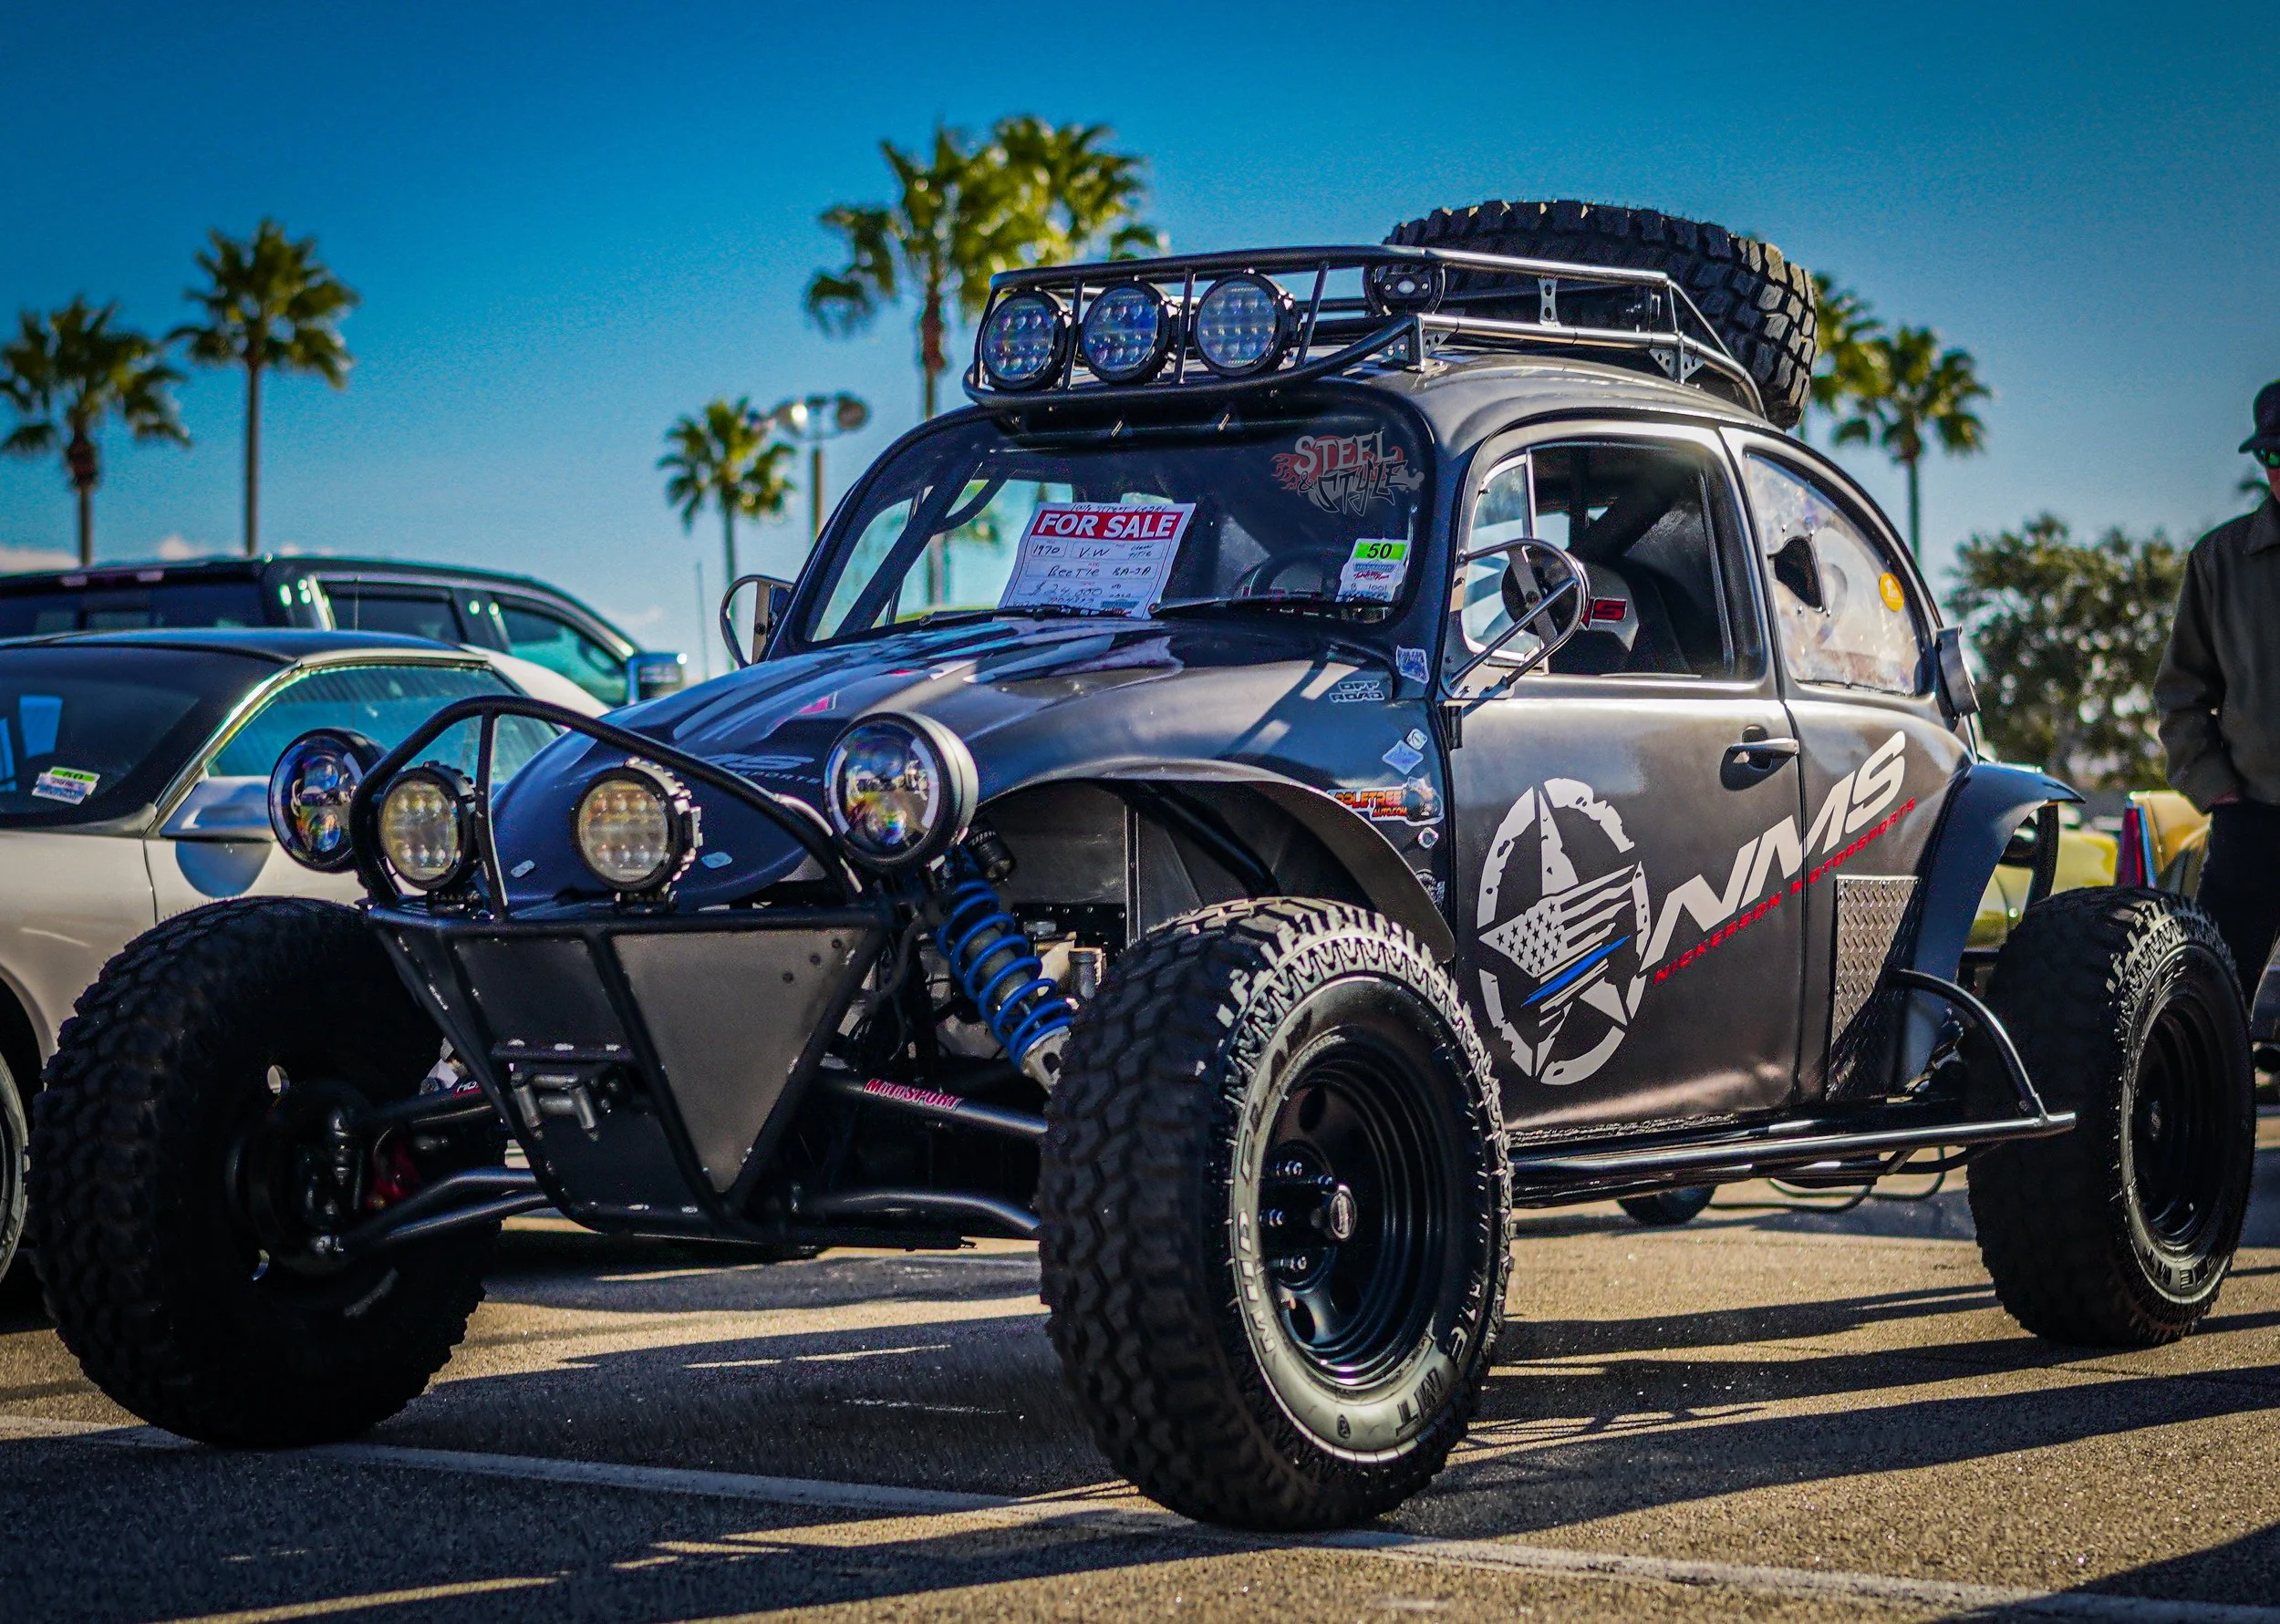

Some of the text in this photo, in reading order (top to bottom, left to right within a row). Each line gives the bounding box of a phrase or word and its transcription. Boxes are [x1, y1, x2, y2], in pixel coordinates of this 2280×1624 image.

[1294, 430, 1398, 474] STEEL
[1298, 460, 1409, 517] & STYLE
[1037, 513, 1177, 538] FOR SALE
[1033, 544, 1060, 555] 1970
[1367, 543, 1393, 559] 50
[1329, 690, 1385, 703] ROAD
[1338, 679, 1380, 692] OFF
[1640, 730, 1906, 973] NMS
[1653, 796, 1917, 987] NICKERSON MOTORSPORTS
[1237, 1007, 1313, 1356] MUD CLAW
[1394, 1369, 1445, 1438] MT
